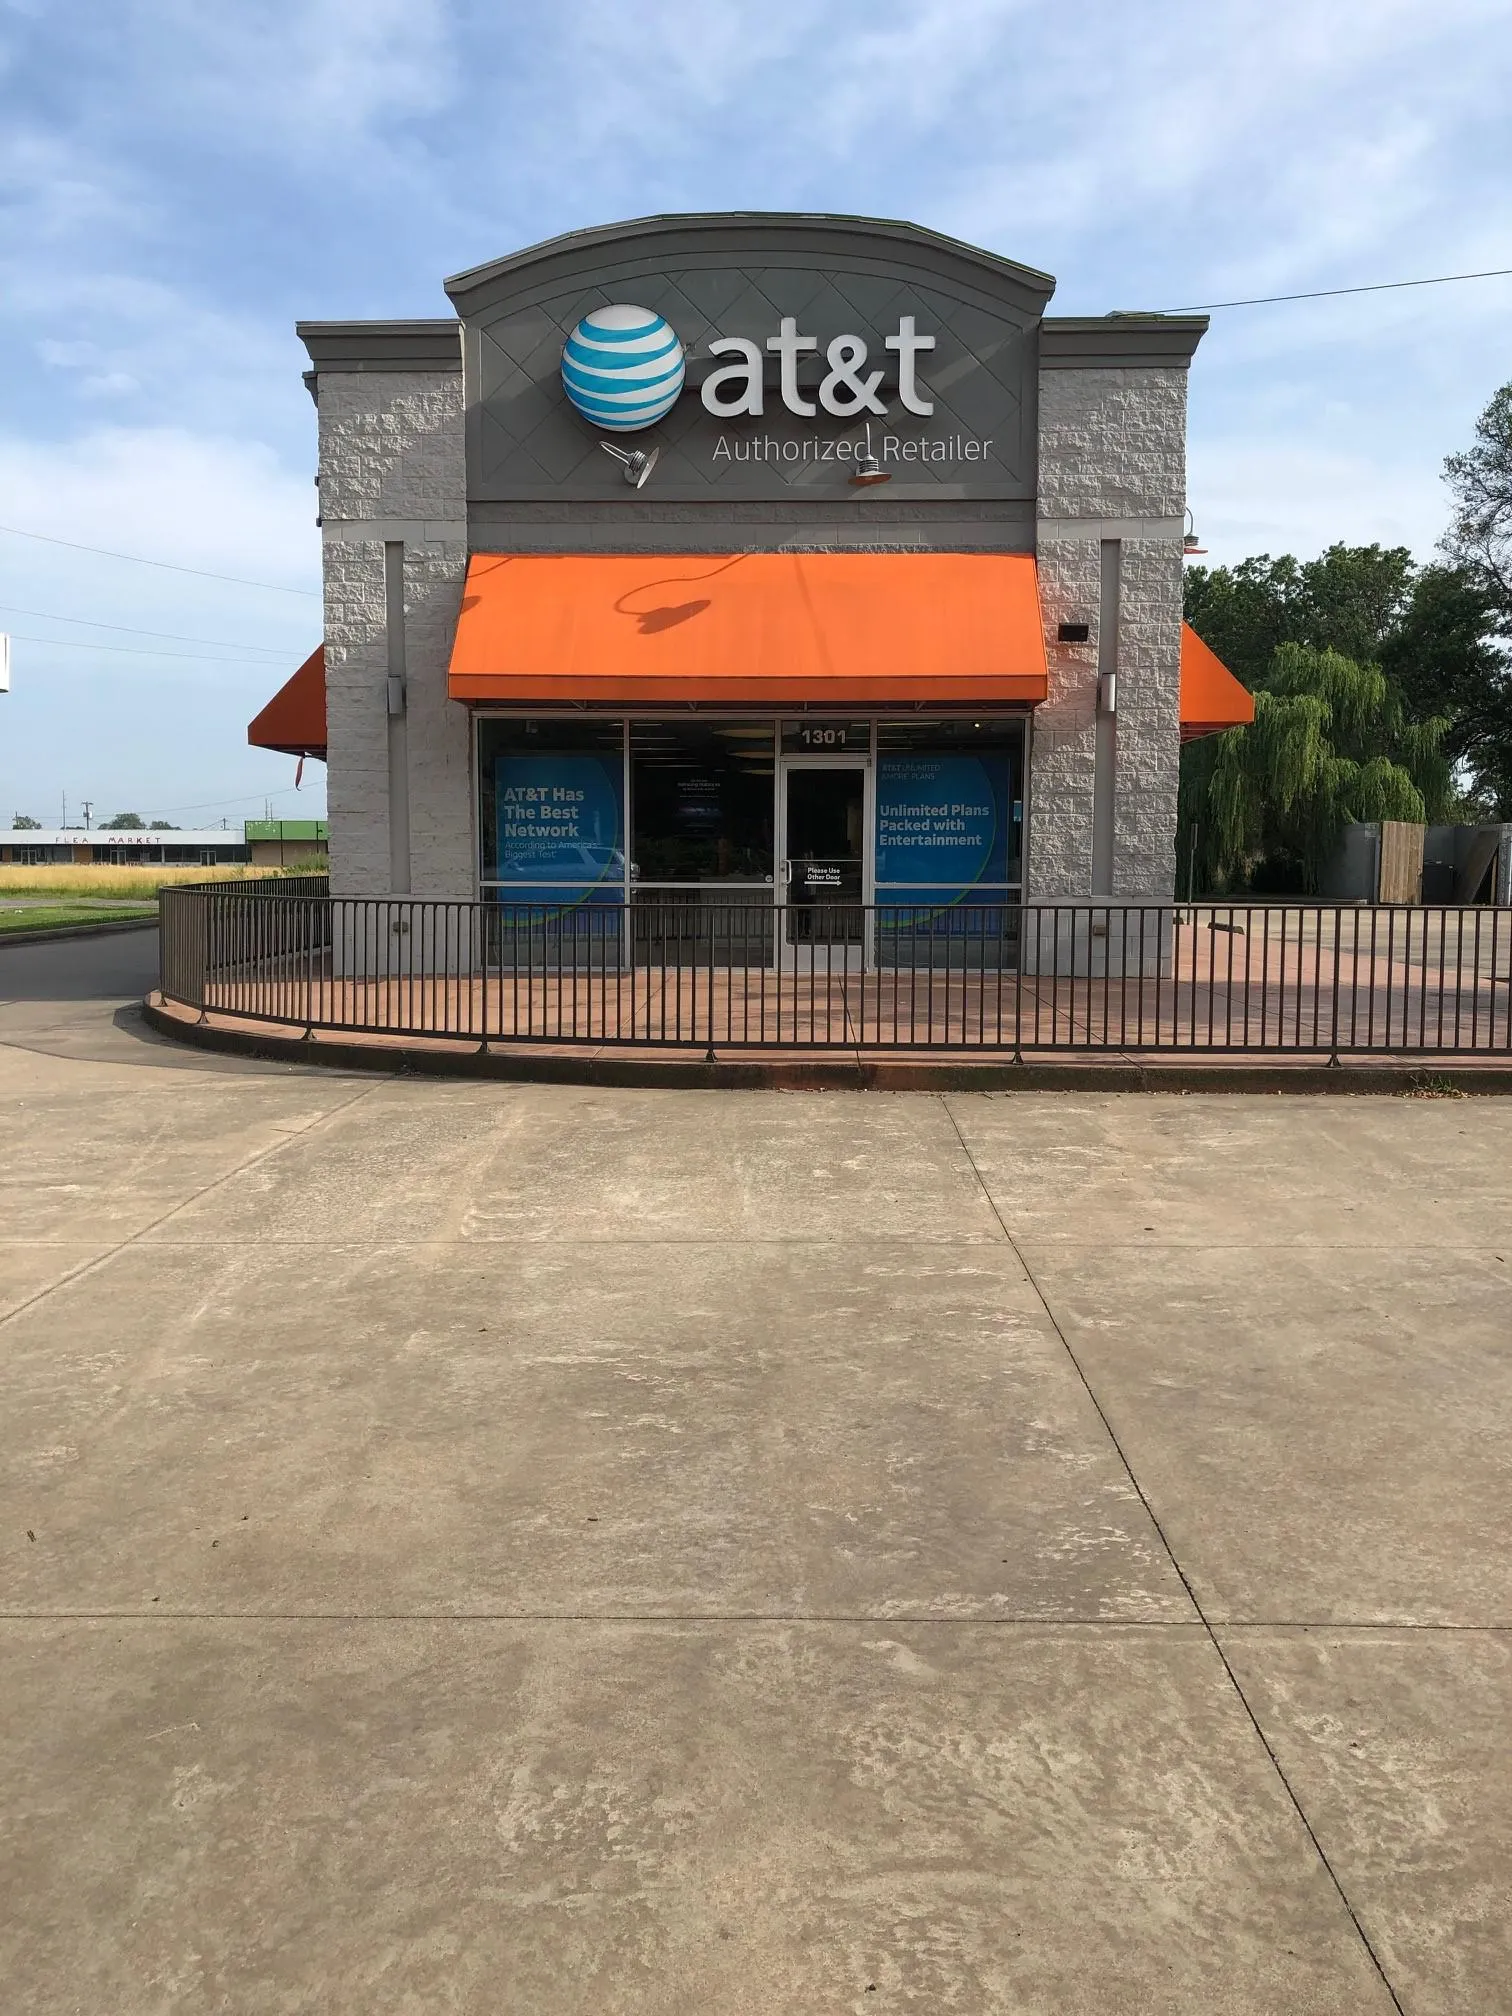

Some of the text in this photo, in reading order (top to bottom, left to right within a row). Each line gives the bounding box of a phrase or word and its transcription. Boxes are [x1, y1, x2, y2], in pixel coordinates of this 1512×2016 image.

[700, 316, 937, 417] at&t
[883, 435, 994, 462] Retailer
[801, 729, 846, 744] 1301
[504, 788, 584, 802] AT&T Has
[504, 805, 579, 819] The Best
[880, 804, 990, 817] Unlimited Plans
[504, 823, 579, 837] Network
[880, 819, 966, 831] Packed with
[505, 841, 546, 850] According
[547, 841, 557, 849] to
[880, 833, 982, 846] Entertainment
[505, 850, 536, 860] Biggest
